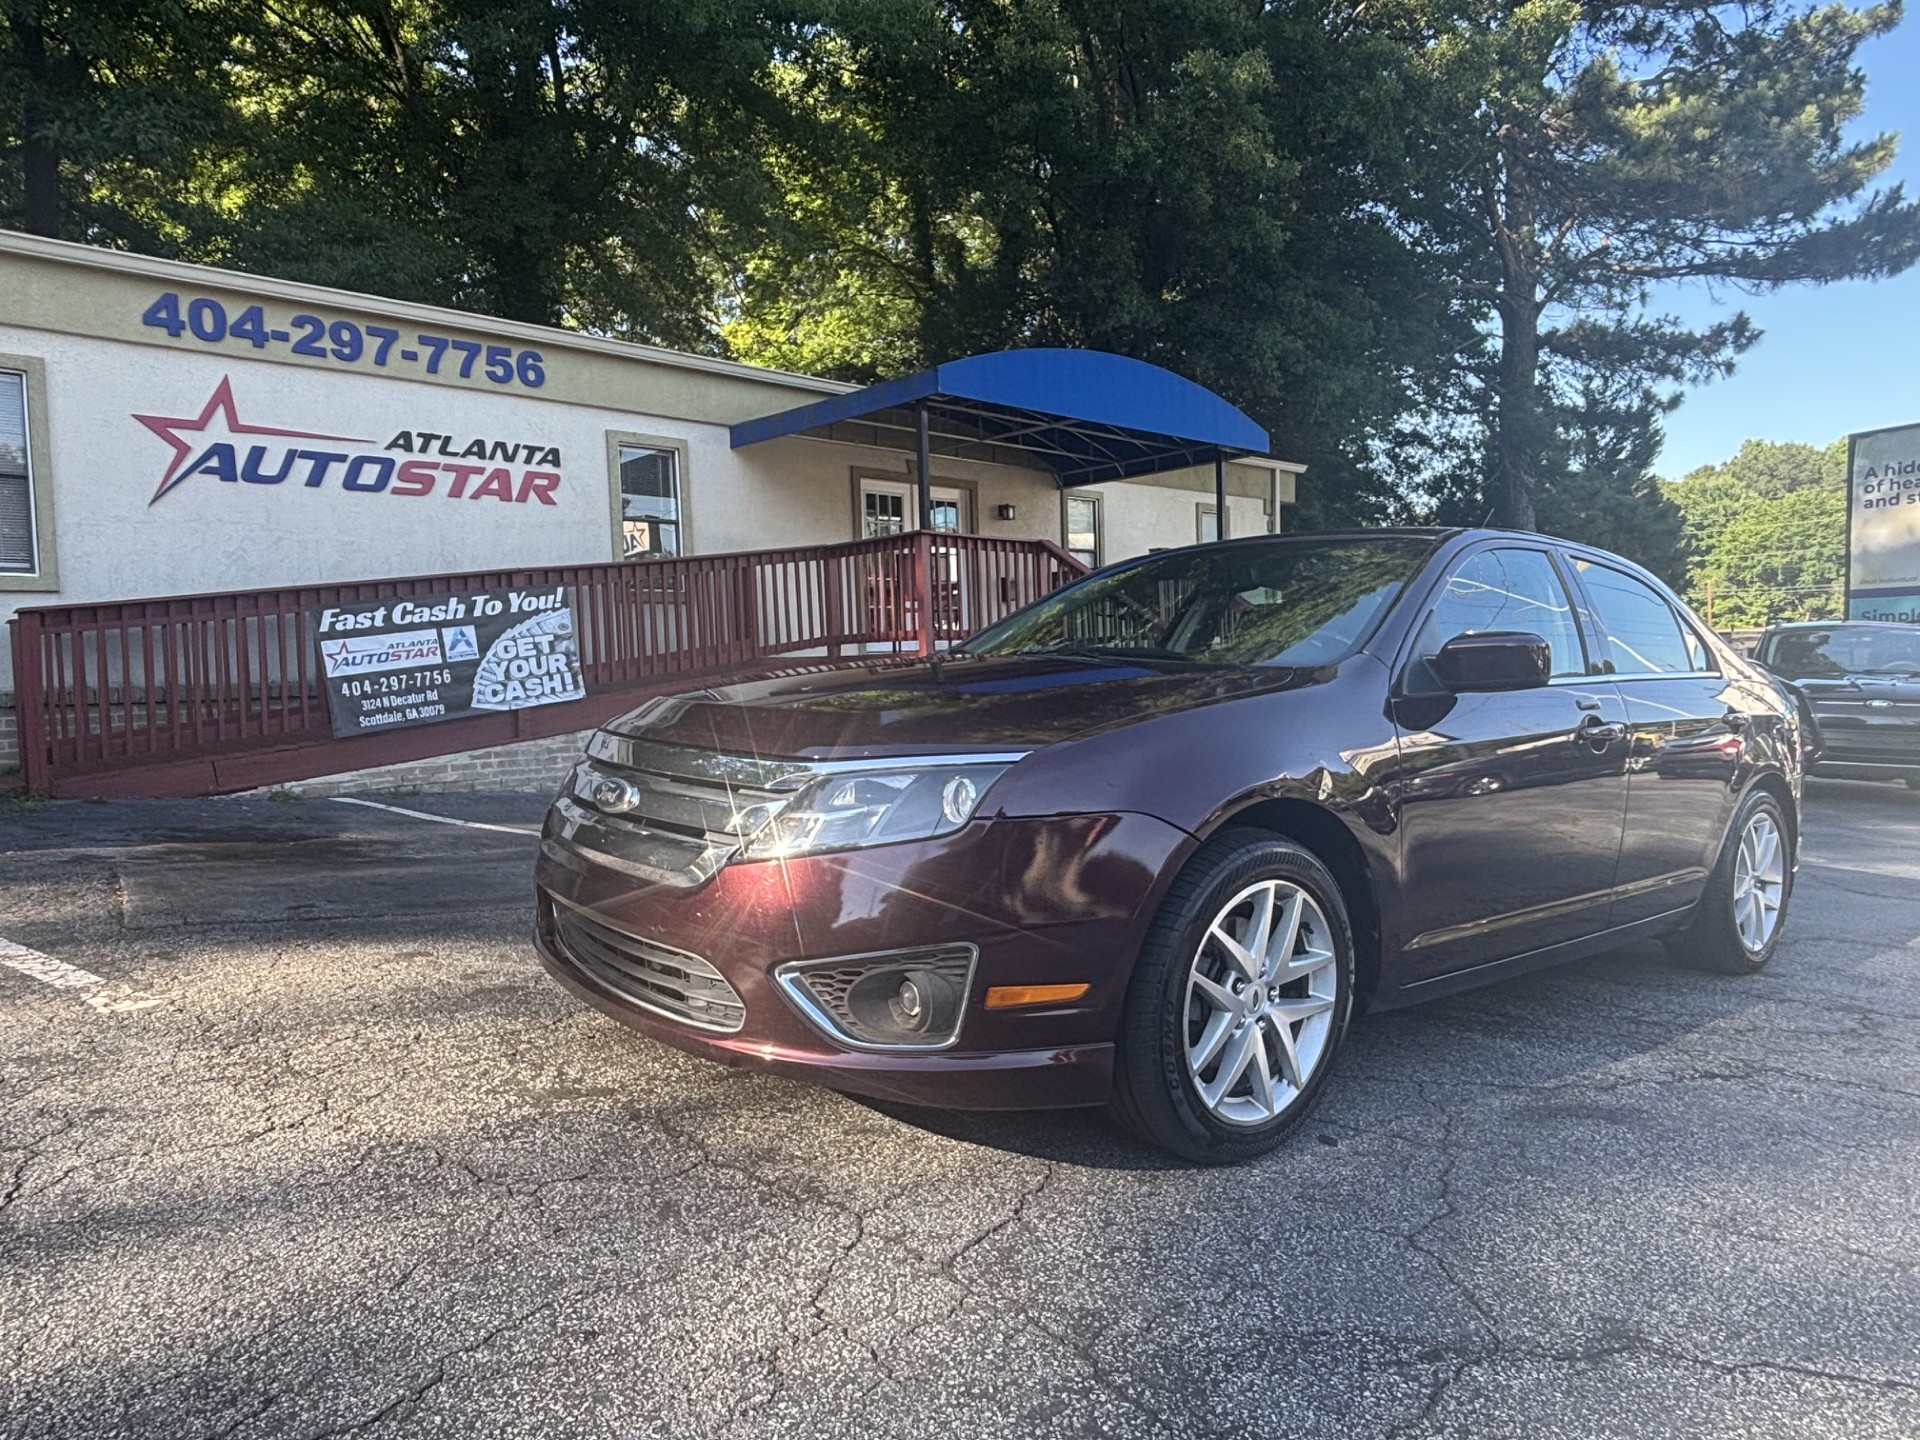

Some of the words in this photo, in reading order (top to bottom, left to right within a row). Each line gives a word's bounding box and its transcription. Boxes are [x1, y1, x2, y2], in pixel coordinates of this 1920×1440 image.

[142, 292, 546, 388] 404-297-7756
[384, 430, 562, 468] ATLANTA
[197, 442, 561, 506] AUTOSTAR
[1864, 466, 1879, 480] A
[1884, 460, 1920, 477] hid
[1864, 479, 1885, 494] of
[1864, 492, 1900, 509] and
[319, 608, 387, 633] Fast
[392, 597, 464, 625] Cash
[472, 595, 502, 617] To
[509, 587, 564, 612] You!
[338, 646, 439, 667] AUTOSTAR
[387, 638, 438, 650] ATLANTA
[497, 634, 554, 659] GET
[489, 653, 569, 681] YOUR
[341, 669, 452, 697] 404-297-7756
[484, 672, 574, 703] CASH!
[361, 697, 382, 711] 3124
[383, 696, 390, 708] N
[390, 692, 426, 707] Decatur
[426, 689, 439, 701] Rd
[359, 710, 406, 728] Scottdale,
[406, 708, 420, 720] GA
[420, 704, 446, 717] 30079
